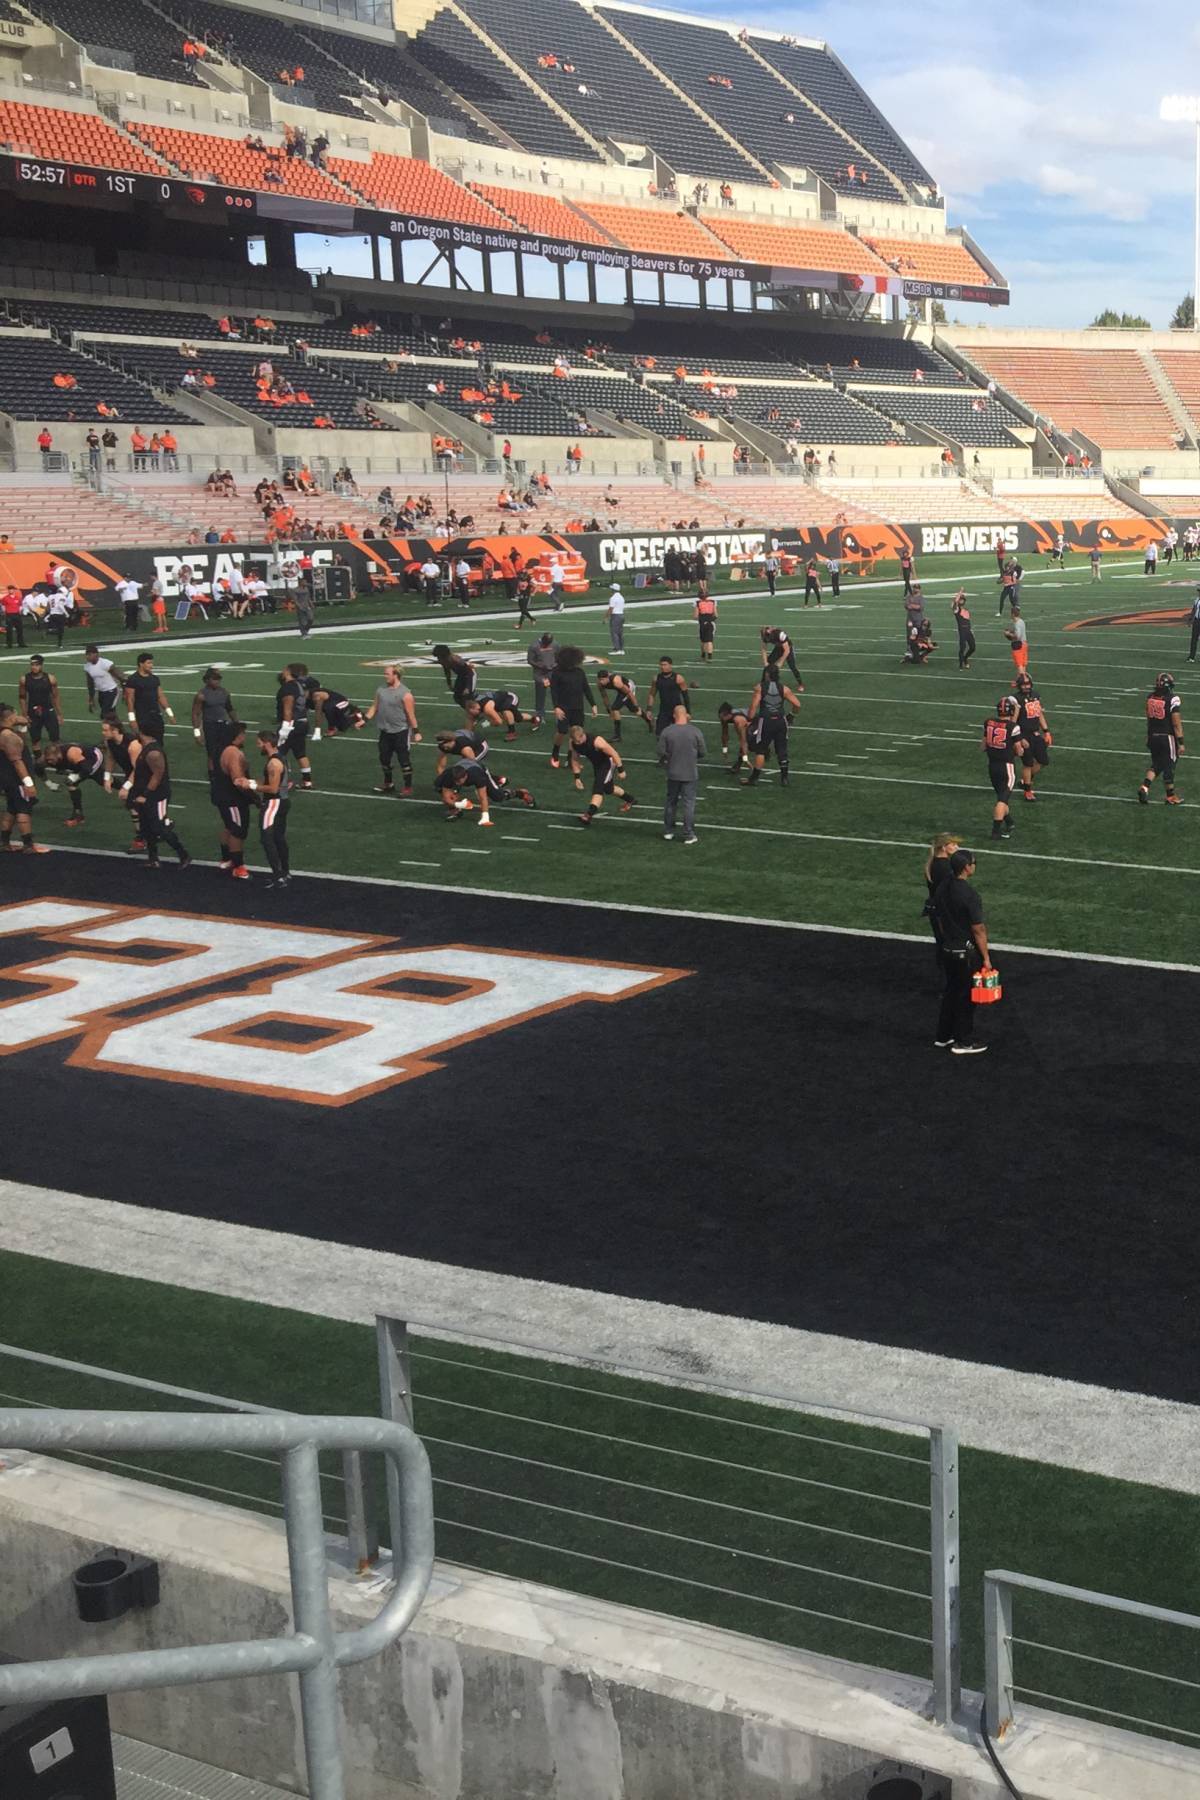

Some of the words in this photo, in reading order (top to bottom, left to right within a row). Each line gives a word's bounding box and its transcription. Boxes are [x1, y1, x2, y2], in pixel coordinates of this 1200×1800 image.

[20, 163, 65, 184] 52:57
[106, 176, 136, 194] 1ST
[160, 183, 170, 198] 0
[390, 220, 405, 233] an
[408, 220, 450, 241] Oregon
[453, 227, 482, 244] State
[485, 234, 518, 249] native
[520, 240, 539, 252] and
[542, 244, 580, 260] proudly
[581, 250, 630, 269] employing
[631, 254, 675, 272] Beavers
[678, 260, 695, 273] for
[698, 262, 712, 275] 75
[714, 266, 745, 280] years
[922, 526, 1018, 552] BEAVERS
[987, 725, 1007, 749] 12
[46, 1741, 56, 1759] 1
